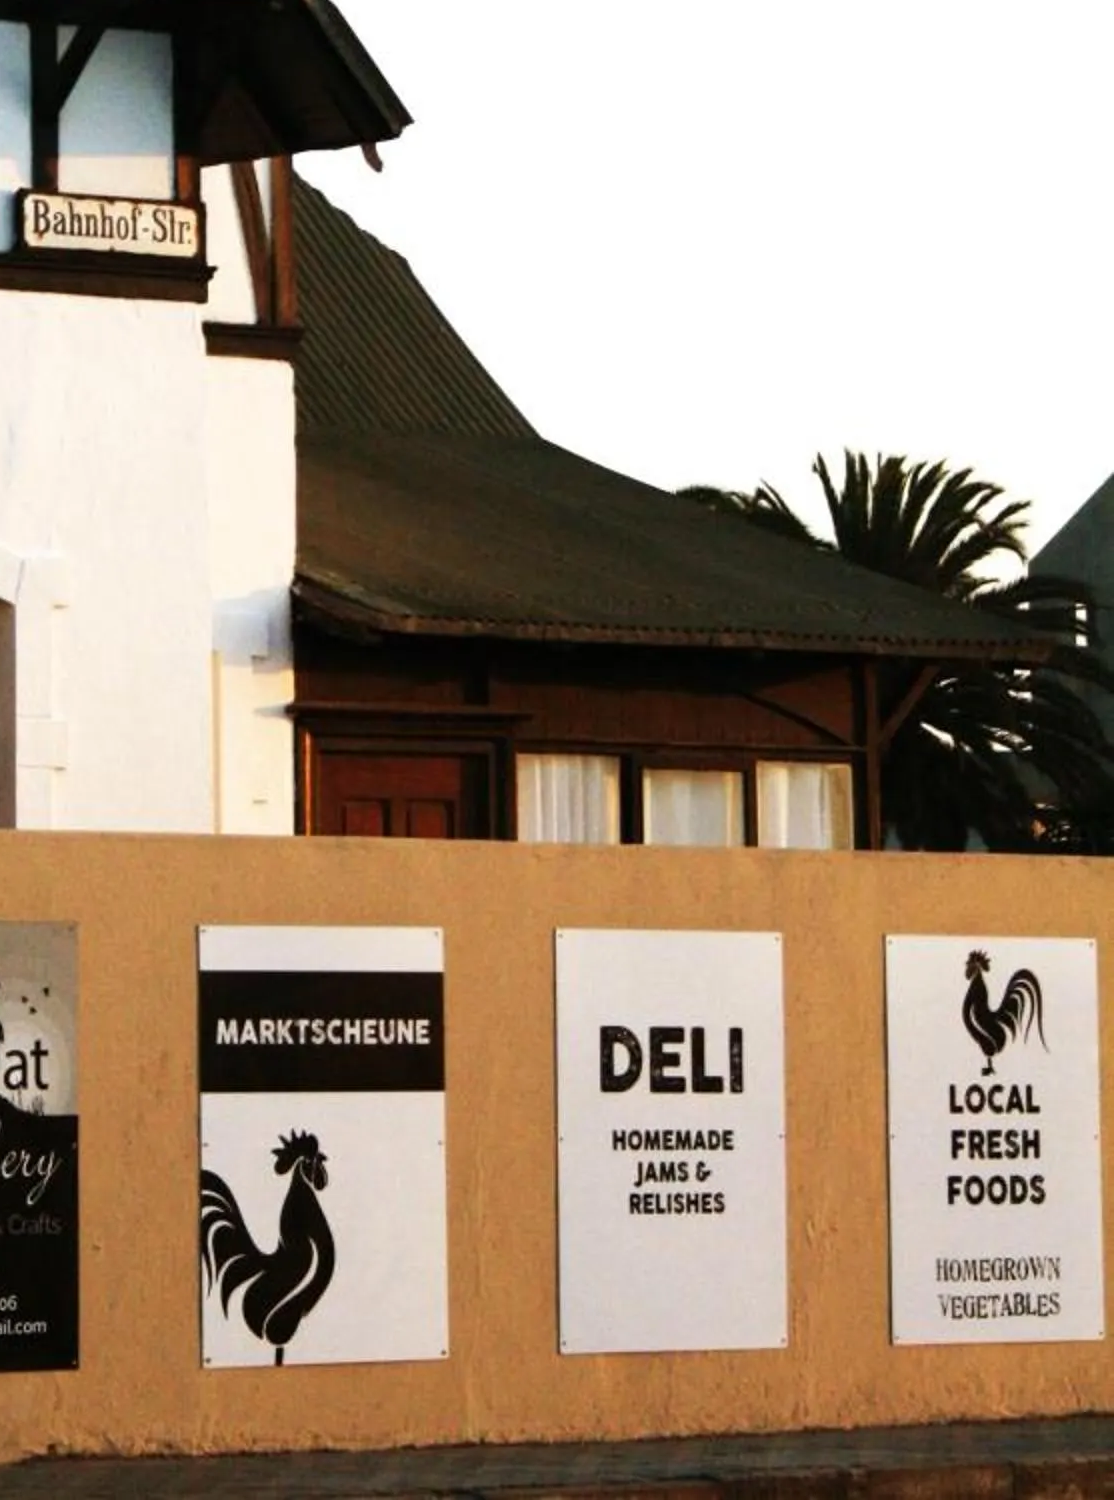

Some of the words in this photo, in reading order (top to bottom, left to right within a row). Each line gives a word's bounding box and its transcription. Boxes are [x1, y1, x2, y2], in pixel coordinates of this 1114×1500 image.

[216, 1019, 431, 1045] MARKTSCHEUNE
[599, 1025, 744, 1093] DELI
[949, 1084, 1040, 1114] LOCAL
[612, 1130, 734, 1151] HOMEMADE
[951, 1129, 1040, 1160] FRESH
[634, 1162, 688, 1187] JAMS
[695, 1163, 711, 1182] &
[947, 1175, 1046, 1205] FOODS
[628, 1193, 725, 1215] RELISHES
[8, 1213, 63, 1235] Crafts
[936, 1256, 1061, 1282] HOMEGROWN
[937, 1292, 1061, 1319] VEGETABLES
